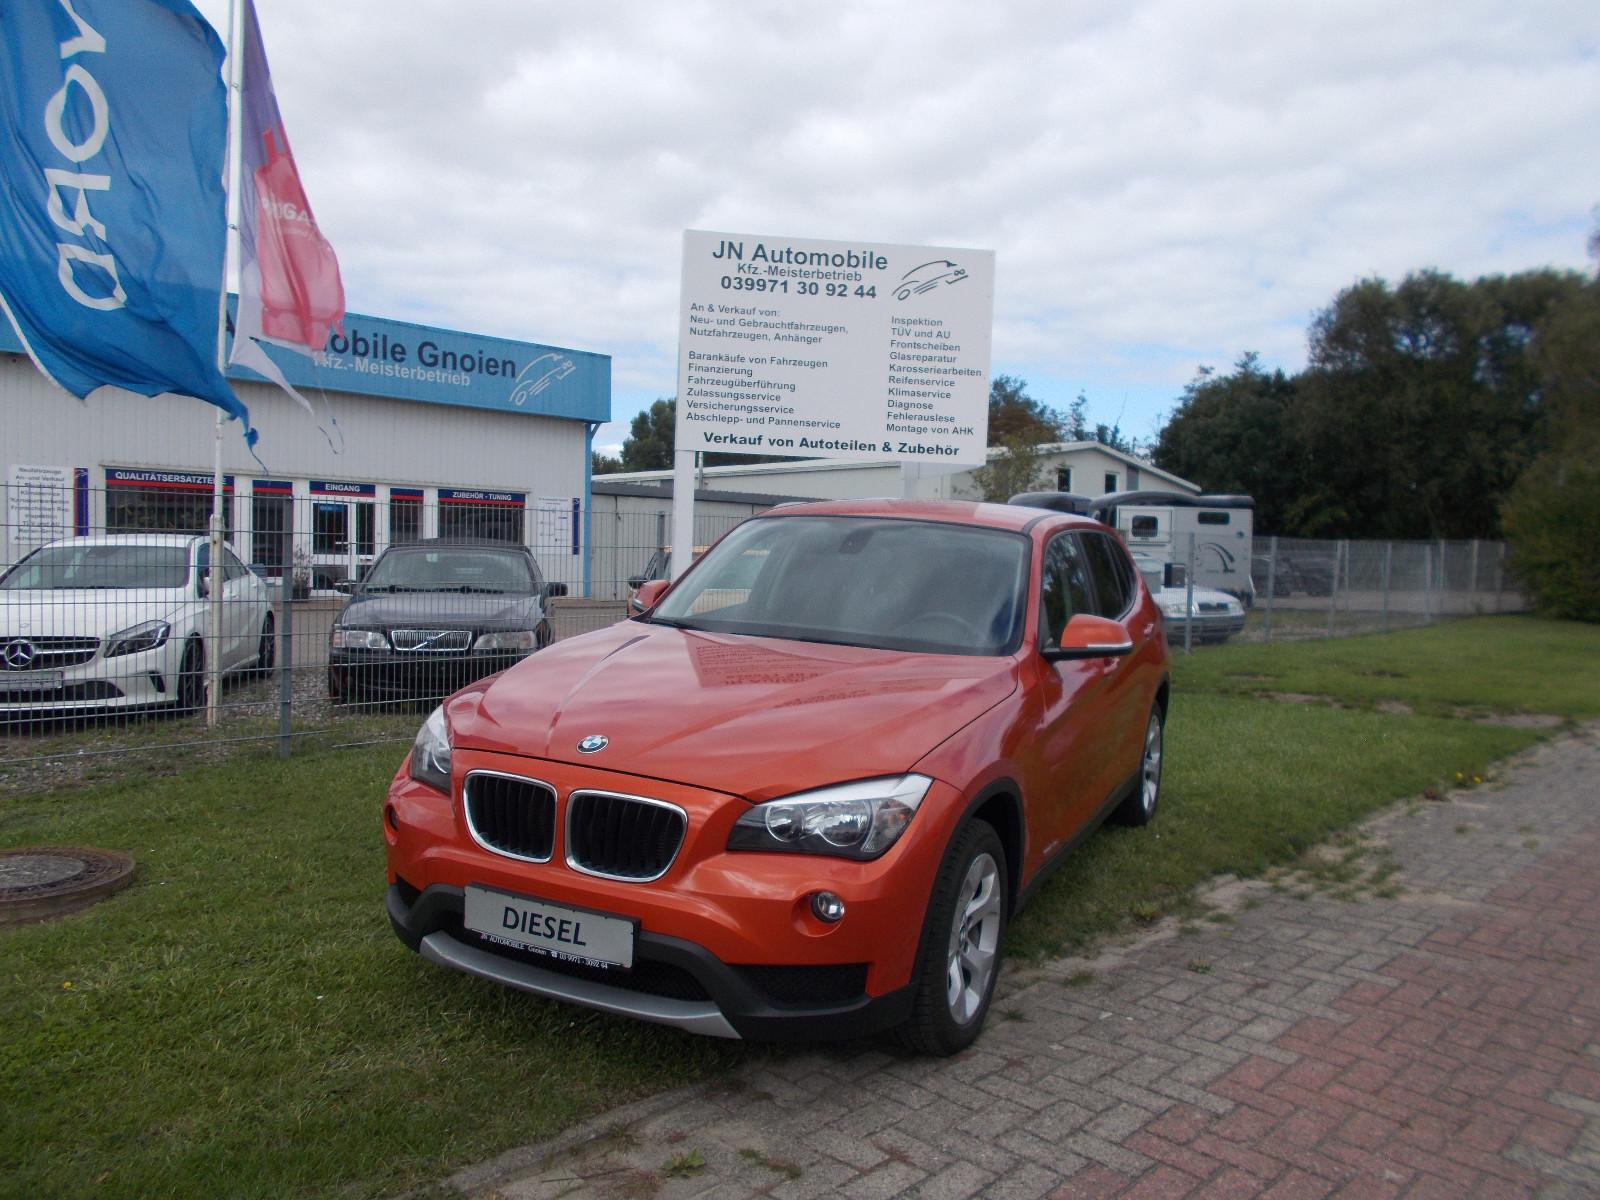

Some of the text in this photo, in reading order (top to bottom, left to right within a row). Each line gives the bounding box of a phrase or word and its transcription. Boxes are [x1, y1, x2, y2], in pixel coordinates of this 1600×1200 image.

[712, 240, 889, 270] JN Automobile
[737, 263, 862, 282] Kfz.-Meisterbetrieb
[720, 276, 877, 299] 039971 30 92 44
[690, 303, 780, 317] An & Verkauf von:
[690, 315, 849, 334] Neu- und Gebrauchtfahrzeugen,
[891, 316, 943, 327] Inspektion
[689, 327, 823, 344] Nutzfahrzeugen, Anhänger
[891, 326, 951, 339] TÜV und AU
[890, 340, 961, 352] Frontscheiben
[417, 341, 517, 379] Gnoien
[688, 351, 828, 369] Barankäufe von Fahrzeugen
[889, 352, 958, 365] Glasreparatur
[688, 363, 753, 377] Finanzierung
[889, 363, 982, 377] Karosseriearbeiten
[688, 375, 796, 392] Fahrzeugüberführung
[888, 376, 955, 387] Reifenservice
[687, 388, 781, 402] Zulassungsservice
[888, 388, 951, 399] Klimaservice
[686, 400, 795, 414] Versicherungsservice
[887, 400, 934, 411] Diagnose
[686, 412, 841, 429] Abschlepp- und Pannenservice
[887, 412, 955, 423] Fehlerauslese
[886, 424, 974, 436] Montage von AHK
[703, 431, 960, 456] Verkauf von Autoteilen & Zubehör
[325, 483, 360, 493] EINGANG
[452, 491, 484, 500] ZUBEHÖR
[502, 906, 586, 946] DIESEL
